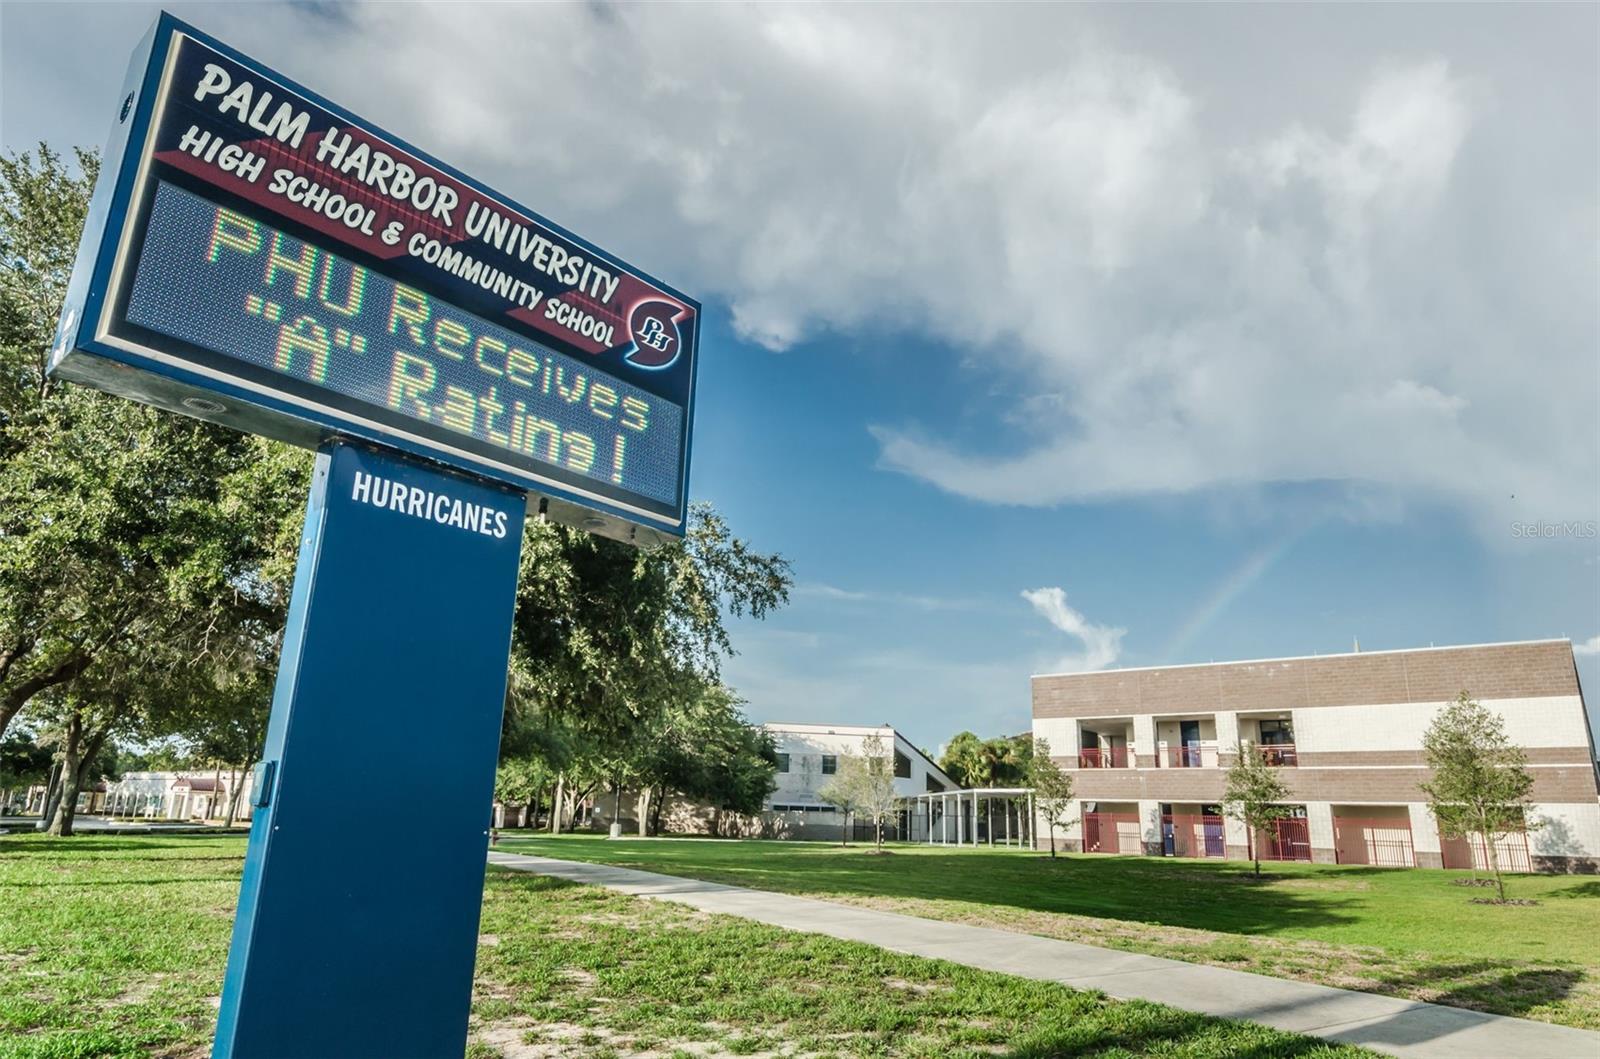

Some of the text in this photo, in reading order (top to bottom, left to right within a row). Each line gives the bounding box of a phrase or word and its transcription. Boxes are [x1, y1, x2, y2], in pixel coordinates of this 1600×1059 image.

[178, 125, 616, 348] HIGH SCHOOL & COMMUNITY SCHOOL
[194, 63, 620, 304] PALM HARBOR UNIVERSITY
[207, 206, 650, 432] PHU Receives
[246, 294, 368, 383] "A"
[352, 471, 508, 539] HURRICANES
